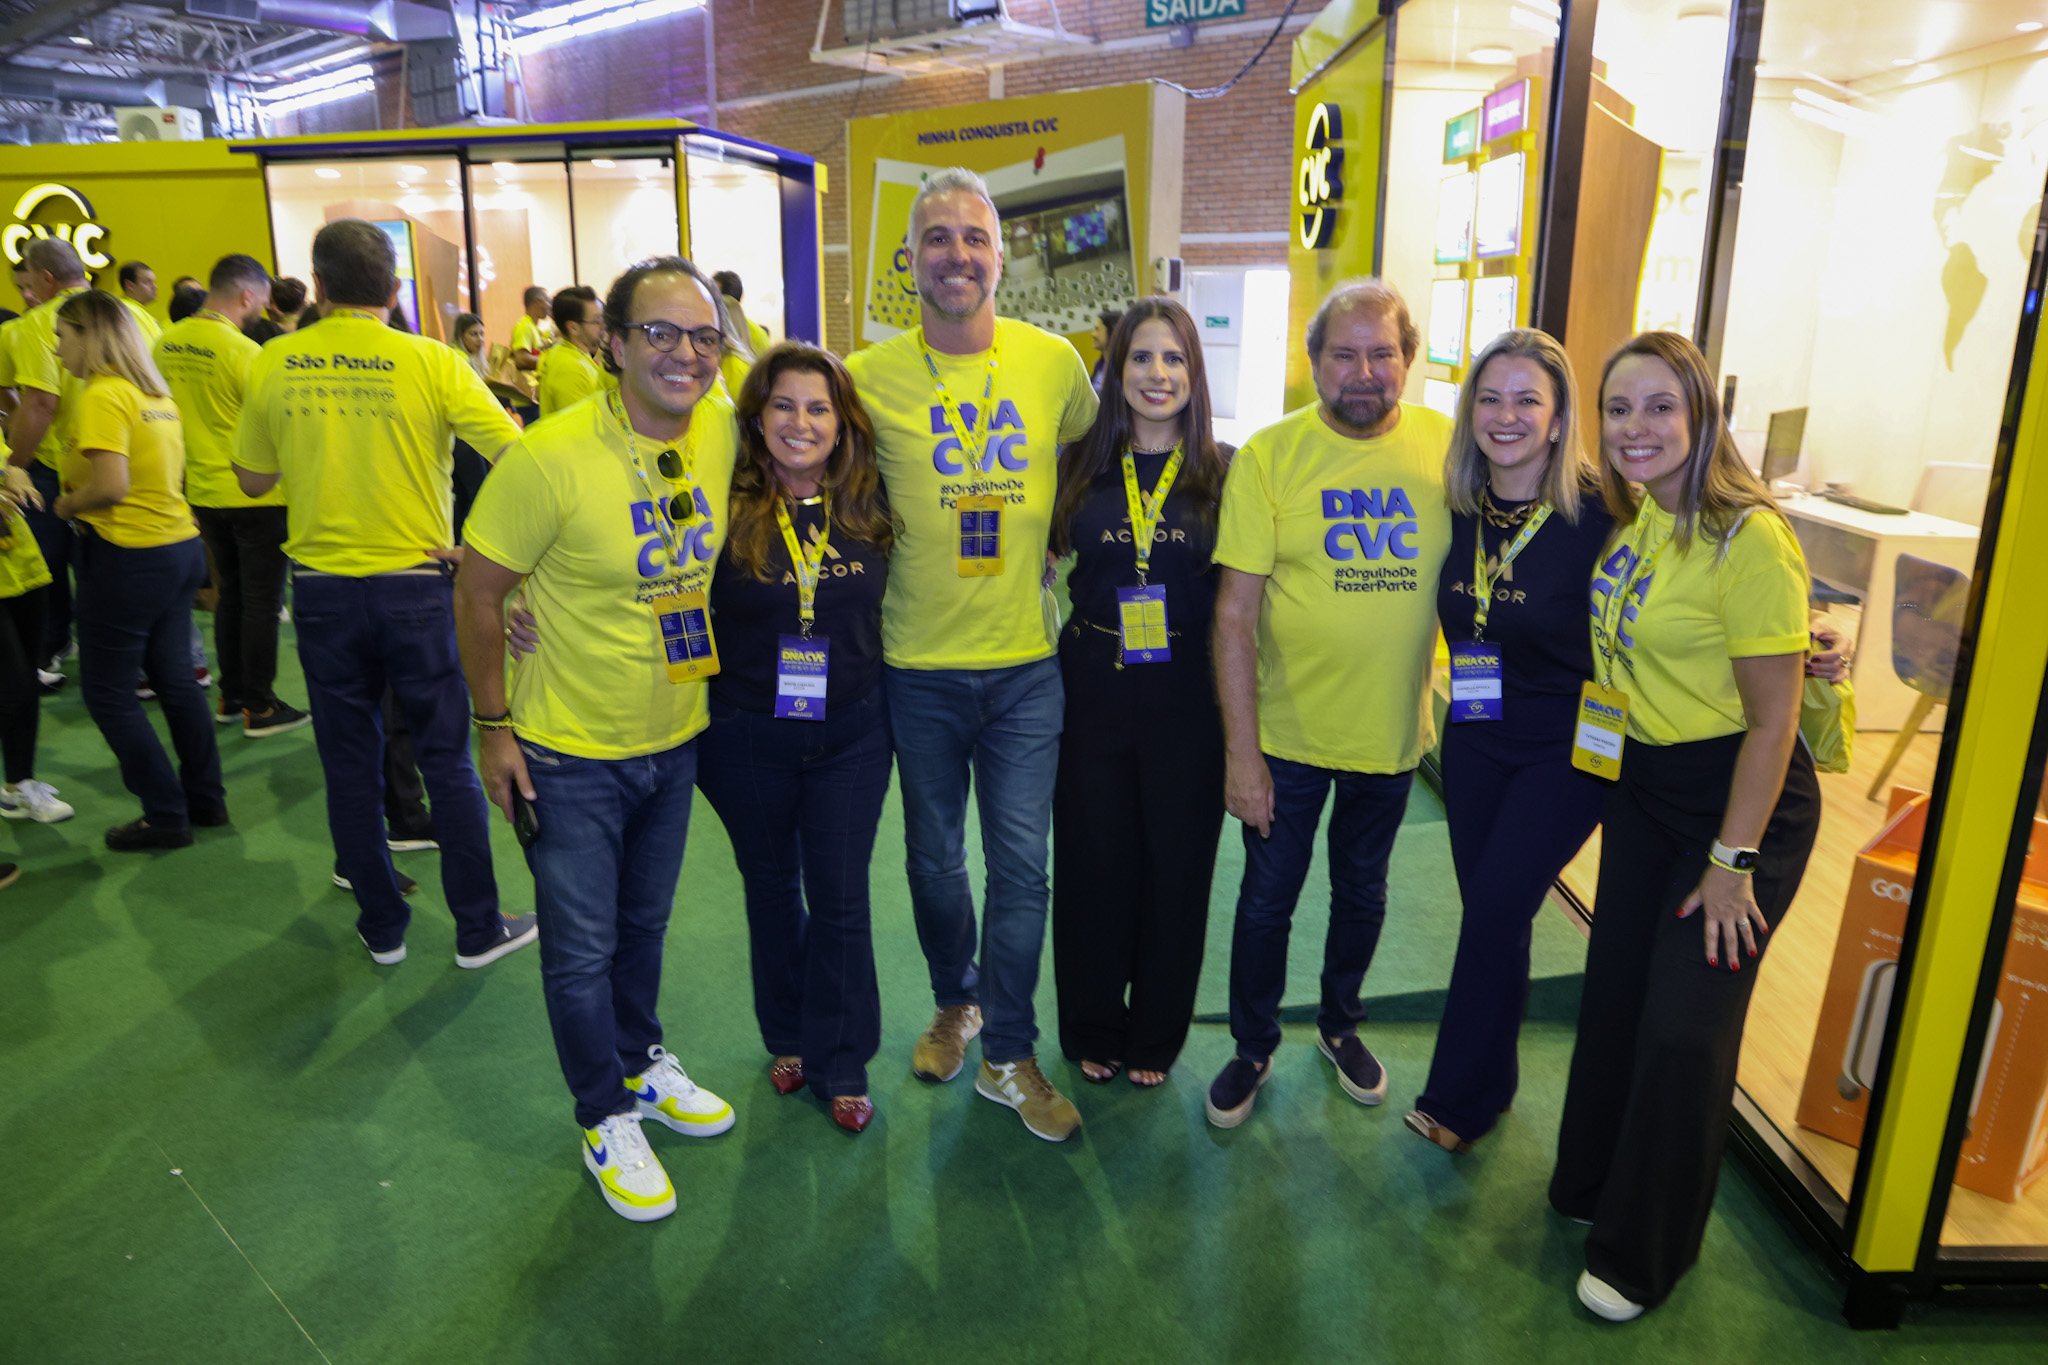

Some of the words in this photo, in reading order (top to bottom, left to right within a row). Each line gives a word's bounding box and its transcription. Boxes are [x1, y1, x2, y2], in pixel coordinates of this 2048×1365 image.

[959, 120, 1031, 142] CONQUISTA
[1032, 117, 1059, 133] CVC
[1299, 146, 1332, 207] CVC
[284, 353, 327, 370] São
[331, 353, 396, 372] Paulo
[1321, 487, 1418, 519] DNA
[1101, 528, 1186, 544] ACOR
[1324, 521, 1420, 561] CVC
[781, 561, 866, 586] ACOR
[1334, 566, 1418, 581] #OrgulhoDe
[1334, 580, 1418, 592] FazerParte
[1450, 581, 1527, 605] ACOR
